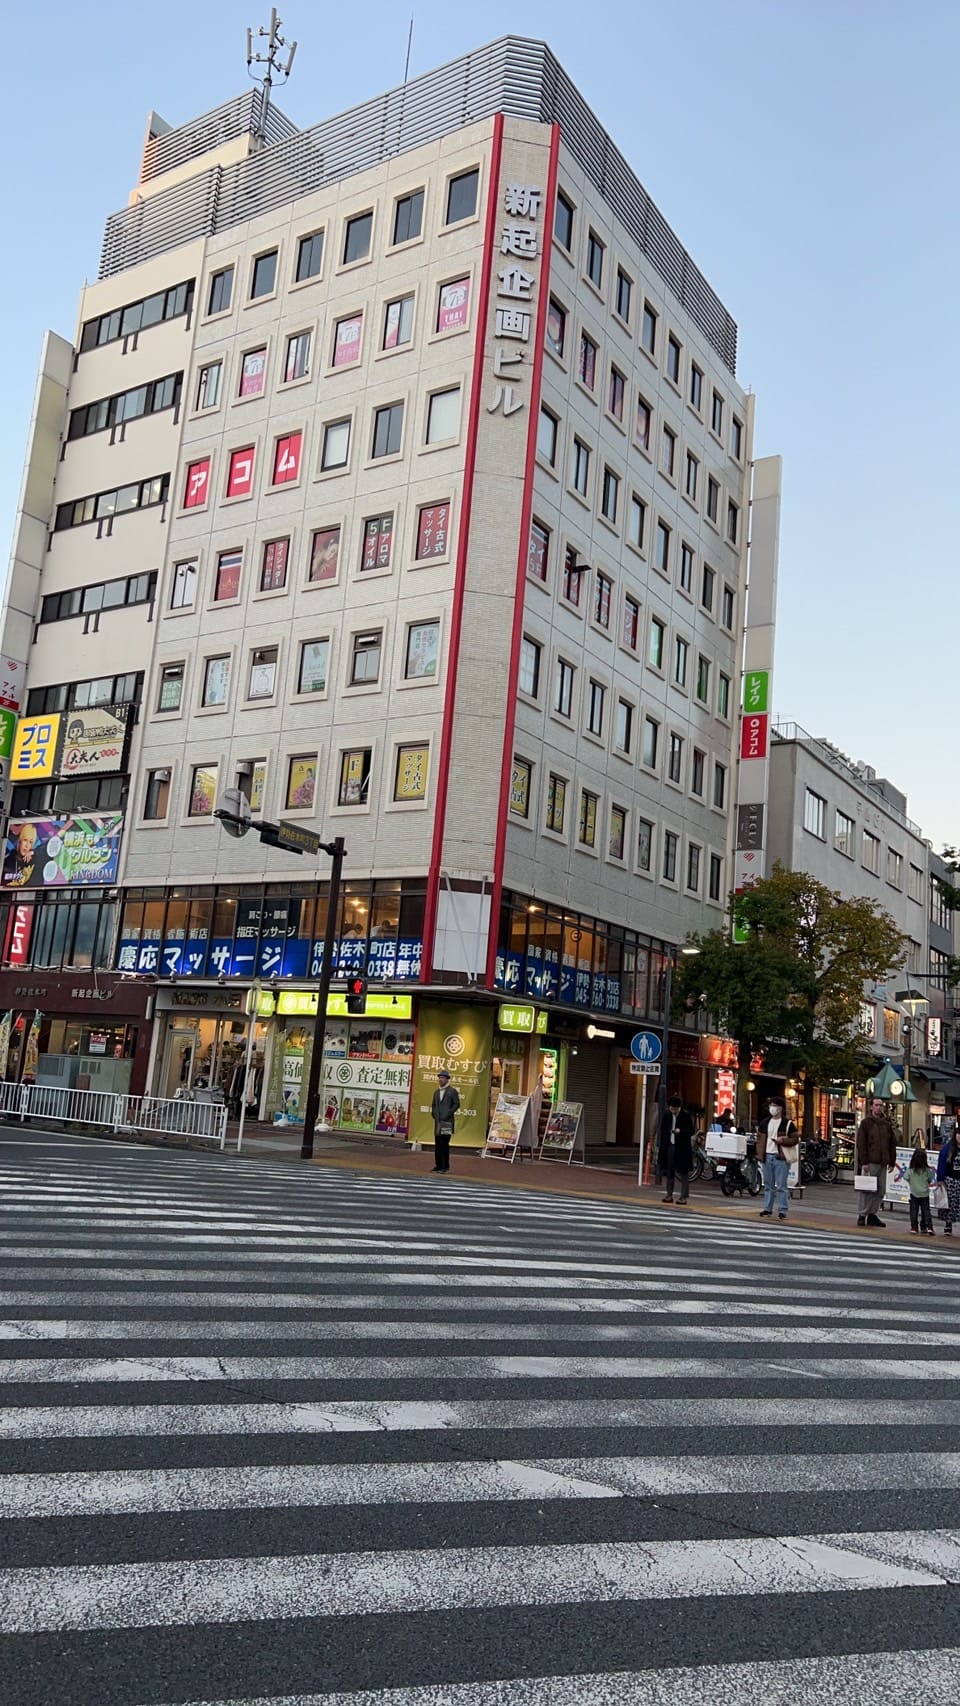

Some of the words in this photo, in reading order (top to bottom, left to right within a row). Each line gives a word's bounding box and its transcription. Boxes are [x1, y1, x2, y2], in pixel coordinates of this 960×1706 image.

[486, 181, 541, 417] 新起企画ビル
[421, 510, 433, 556] マッサージ
[434, 507, 447, 553] タイ古式
[366, 537, 376, 567] オイル
[379, 533, 390, 564] アロマ
[749, 677, 760, 705] レイク
[22, 723, 52, 746] プロ
[18, 748, 46, 769] ミス
[412, 753, 424, 791] タイ古式
[402, 753, 413, 793] マッサージ
[237, 925, 296, 938] 指圧マッサージ
[118, 944, 281, 971] 慶応マッサージ
[502, 1009, 531, 1027] 買取
[357, 1066, 410, 1087] 査定無料
[418, 1054, 488, 1074] 買取むすび
